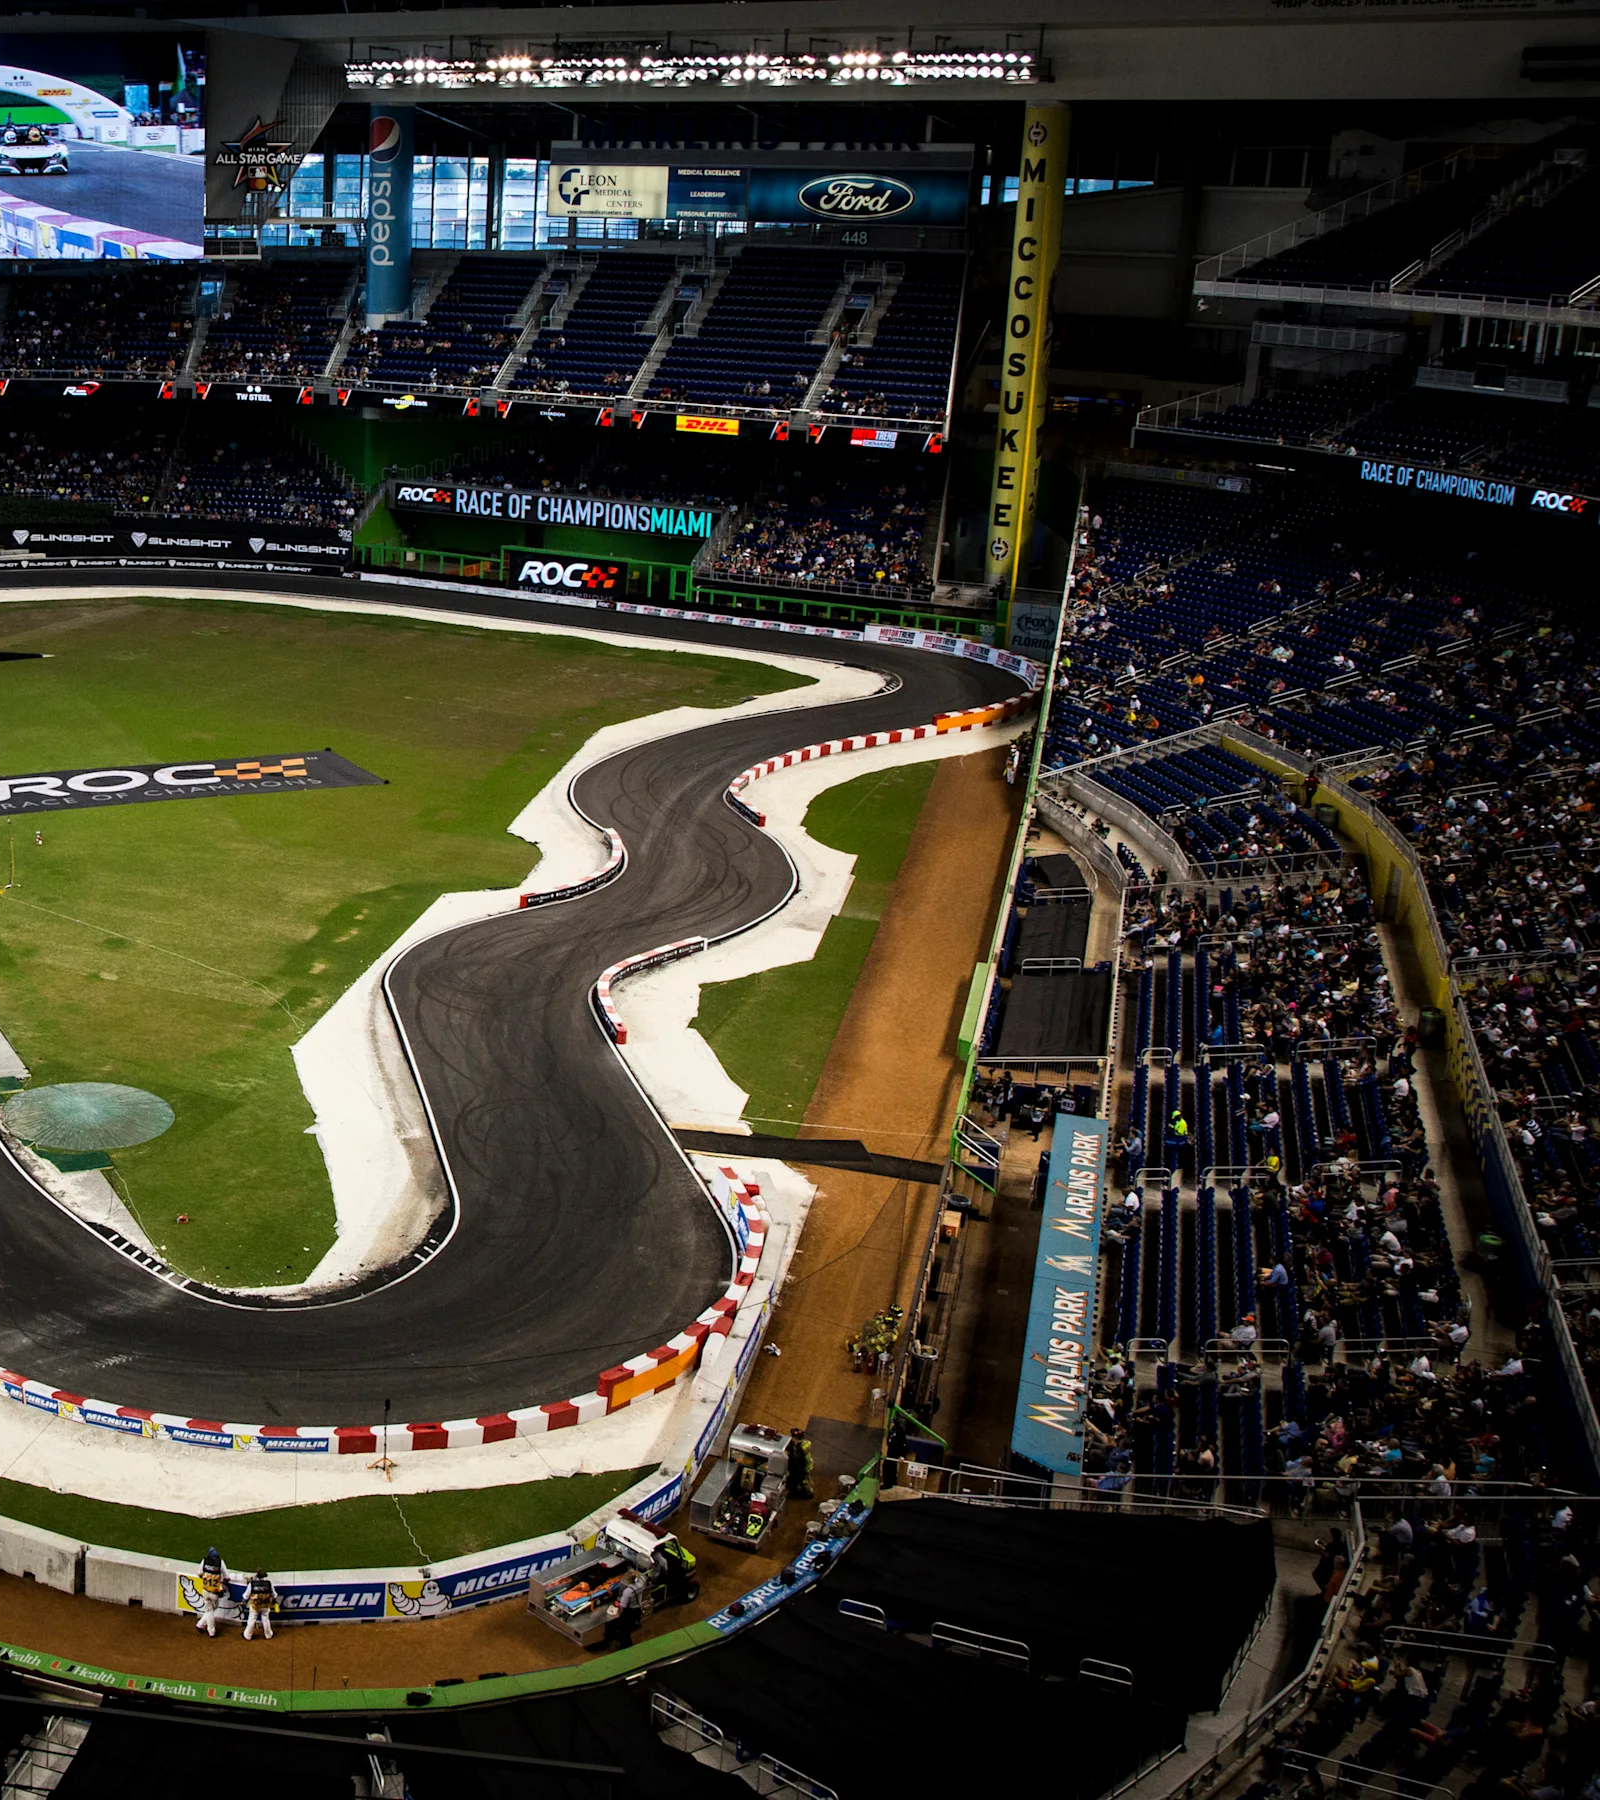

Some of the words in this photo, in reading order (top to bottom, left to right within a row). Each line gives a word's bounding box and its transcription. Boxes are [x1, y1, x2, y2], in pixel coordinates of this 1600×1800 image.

[215, 153, 237, 164] ALL
[239, 153, 265, 164] STAR
[267, 153, 301, 165] GAME
[579, 174, 618, 187] LEON
[594, 189, 633, 198] MEDICAL
[690, 190, 726, 198] LEADERSHIP
[819, 180, 890, 213] Ford
[606, 200, 643, 209] CENTERS
[369, 172, 396, 267] pepsi
[841, 230, 868, 246] 448
[993, 157, 1046, 528] MICCOSUKEE
[236, 393, 247, 401] TW
[249, 393, 272, 402] STEEL
[685, 419, 730, 432] DHL
[1361, 460, 1393, 484] RACE
[1397, 466, 1414, 487] OF
[1415, 469, 1516, 507] CHAMPIONS.COM
[397, 487, 437, 502] ROC
[1531, 490, 1571, 512] ROC
[455, 488, 503, 517] RACE
[508, 494, 532, 520] OF
[29, 533, 114, 543] SLINGSHOT
[338, 529, 352, 538] 392
[148, 537, 232, 548] SLINGSHOT
[265, 543, 349, 555] SLINGSHOT
[518, 561, 588, 588] ROC
[1025, 617, 1047, 628] FOX
[1011, 635, 1056, 649] FLORIDA
[0, 797, 76, 811] RACE
[91, 792, 129, 802] OF
[143, 776, 322, 799] CHAMPIONS
[1072, 1130, 1102, 1168] PARK
[1048, 1168, 1101, 1241] MARLINS
[1051, 1287, 1089, 1337] PARK
[1026, 1337, 1086, 1436] MARLINS
[85, 1411, 142, 1430] MICHELIN
[172, 1428, 233, 1444] MICHELIN
[266, 1439, 327, 1449] MICHELIN
[275, 1593, 382, 1609] ICHELIN
